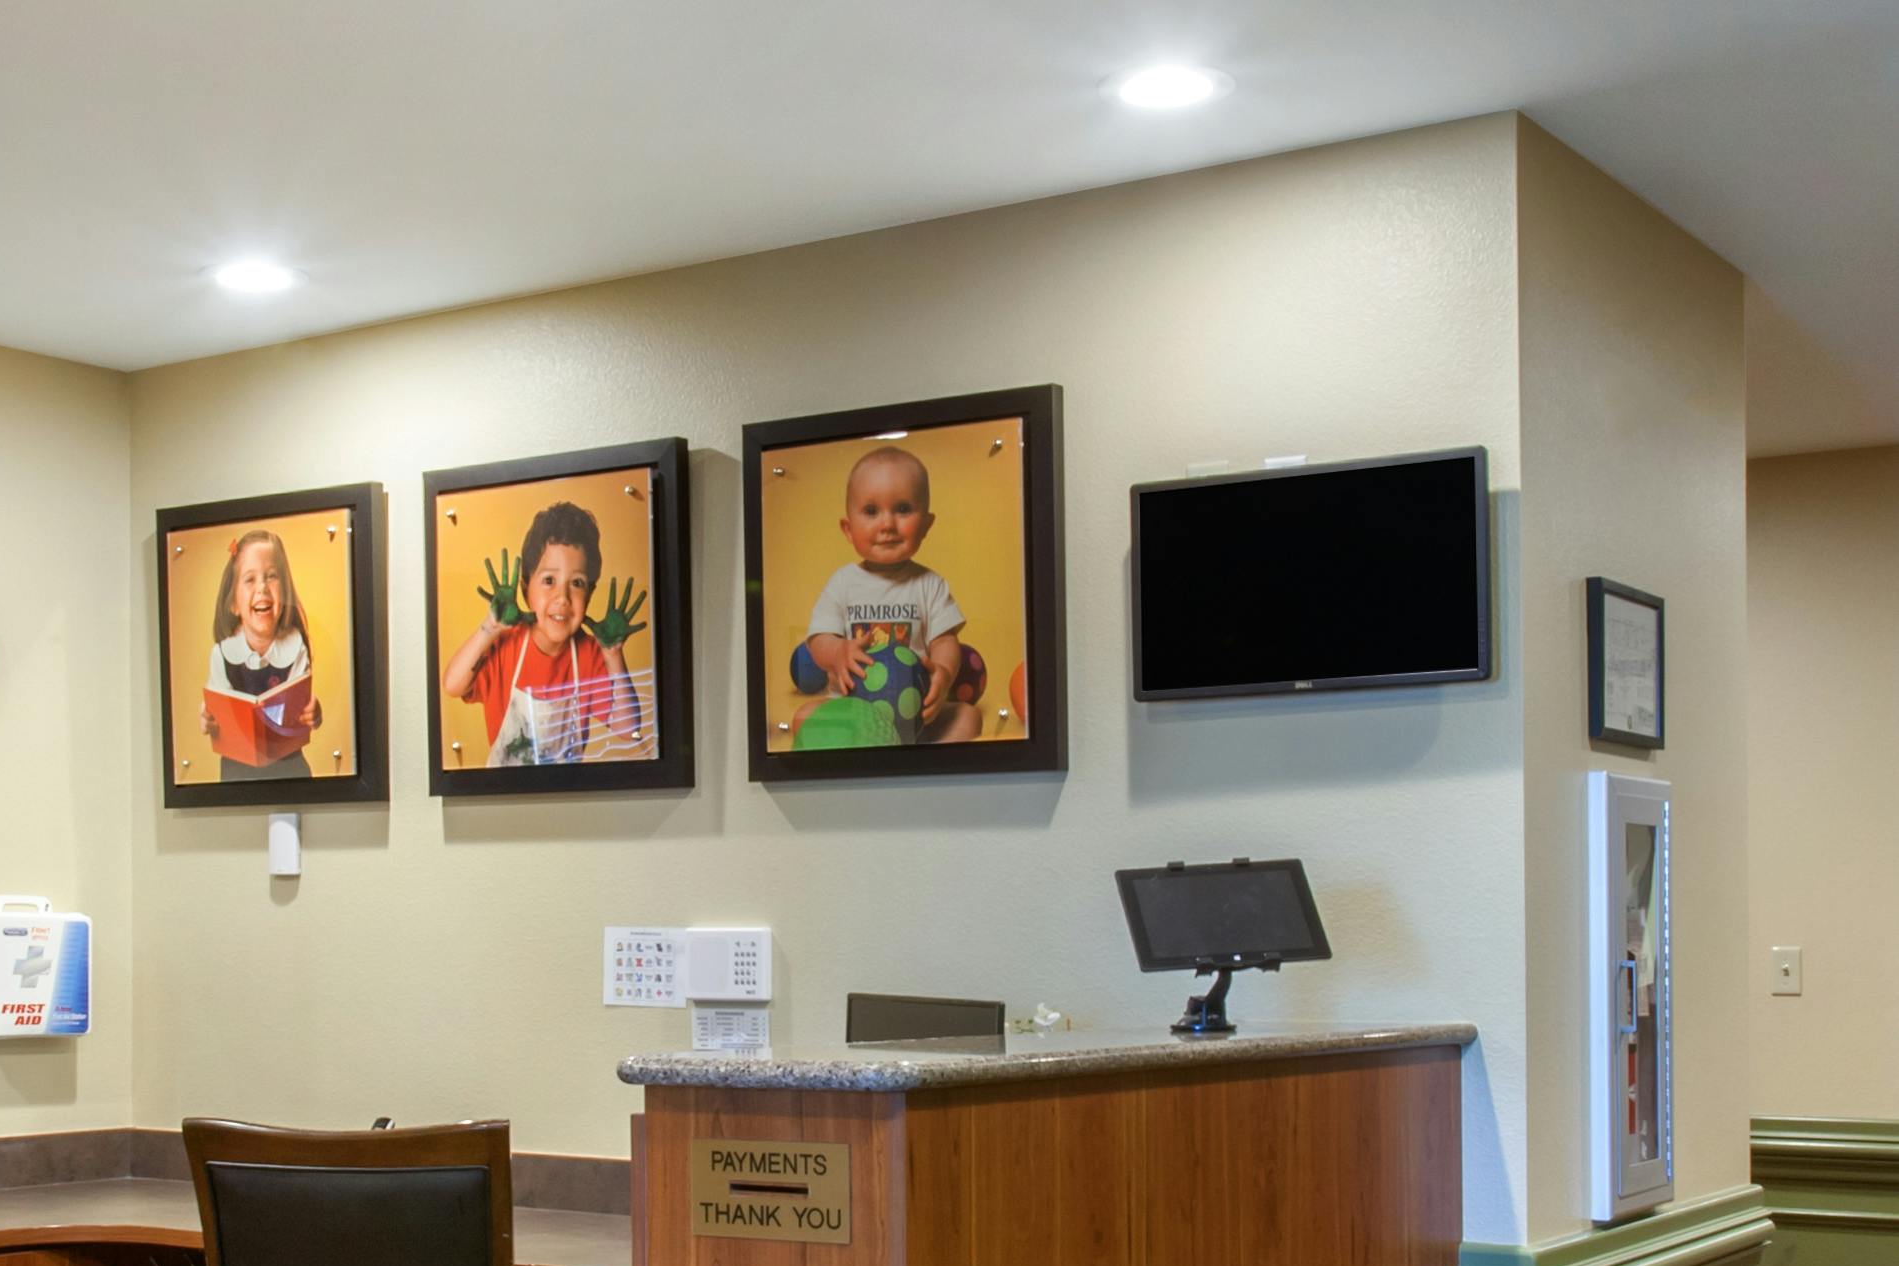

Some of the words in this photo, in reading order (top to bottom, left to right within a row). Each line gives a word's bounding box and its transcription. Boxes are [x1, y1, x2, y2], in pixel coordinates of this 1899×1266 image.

[846, 603, 918, 621] PRIMROSE
[1, 1003, 45, 1014] FIRST
[14, 1015, 43, 1026] AID
[711, 1150, 828, 1176] PAYMENTS
[699, 1202, 782, 1228] THANK
[792, 1205, 842, 1230] YOU
